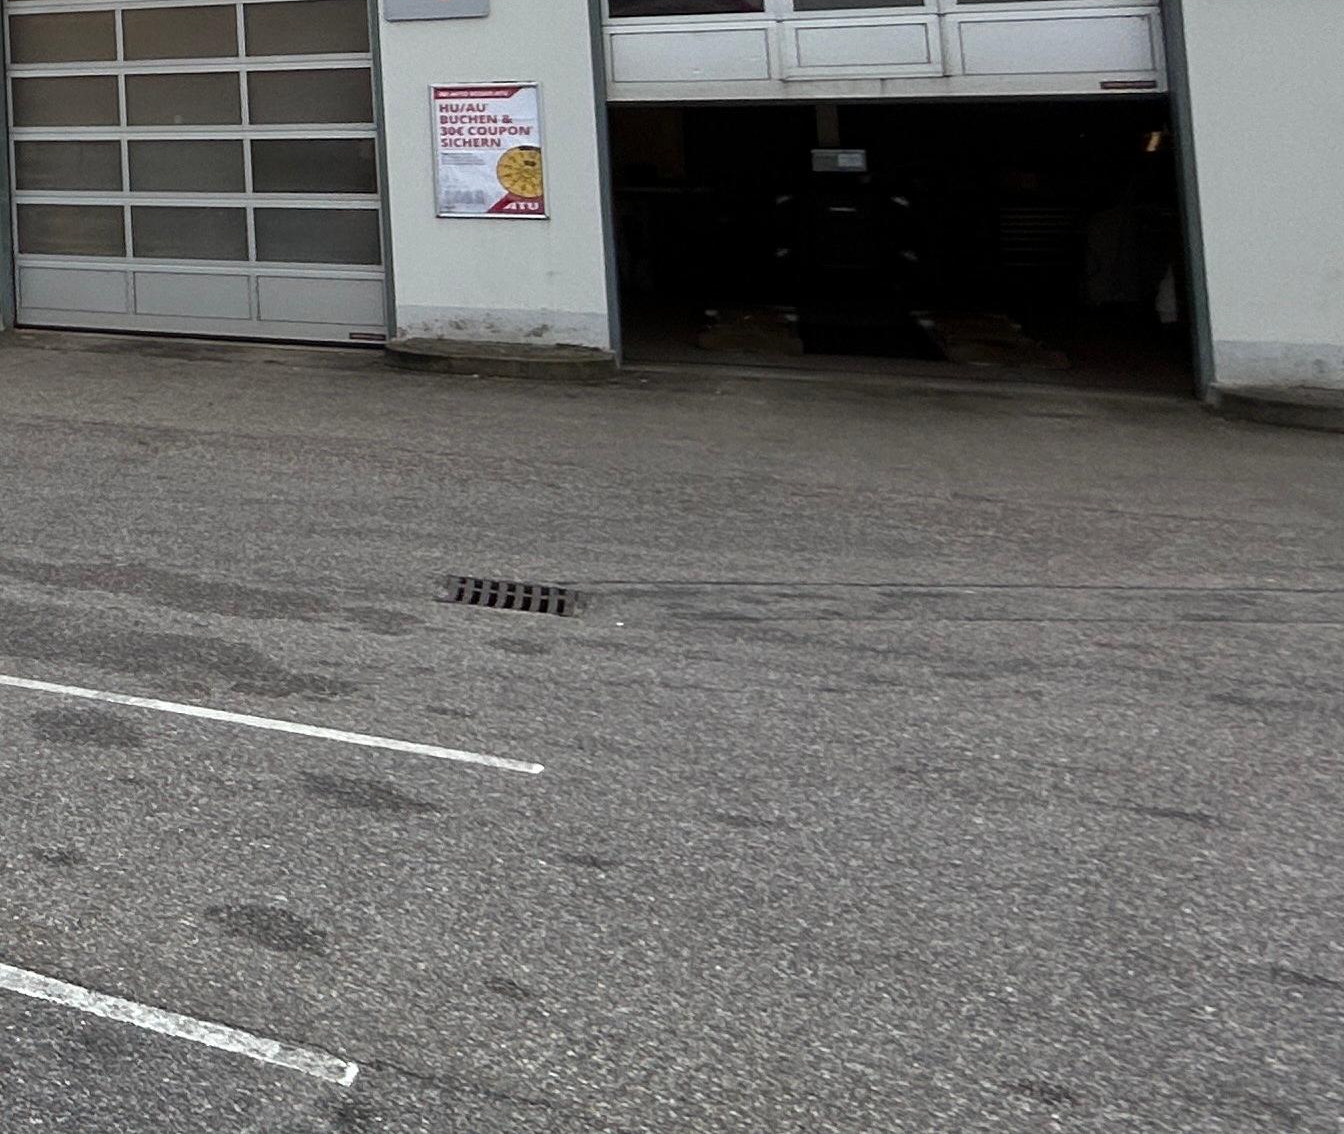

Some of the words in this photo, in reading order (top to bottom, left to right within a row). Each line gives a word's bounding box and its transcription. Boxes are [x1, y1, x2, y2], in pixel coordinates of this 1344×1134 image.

[439, 115, 497, 124] BUCHEN
[501, 115, 512, 124] &
[440, 126, 464, 136] 30€
[441, 138, 502, 147] SICHERN
[503, 202, 540, 211] ATU
